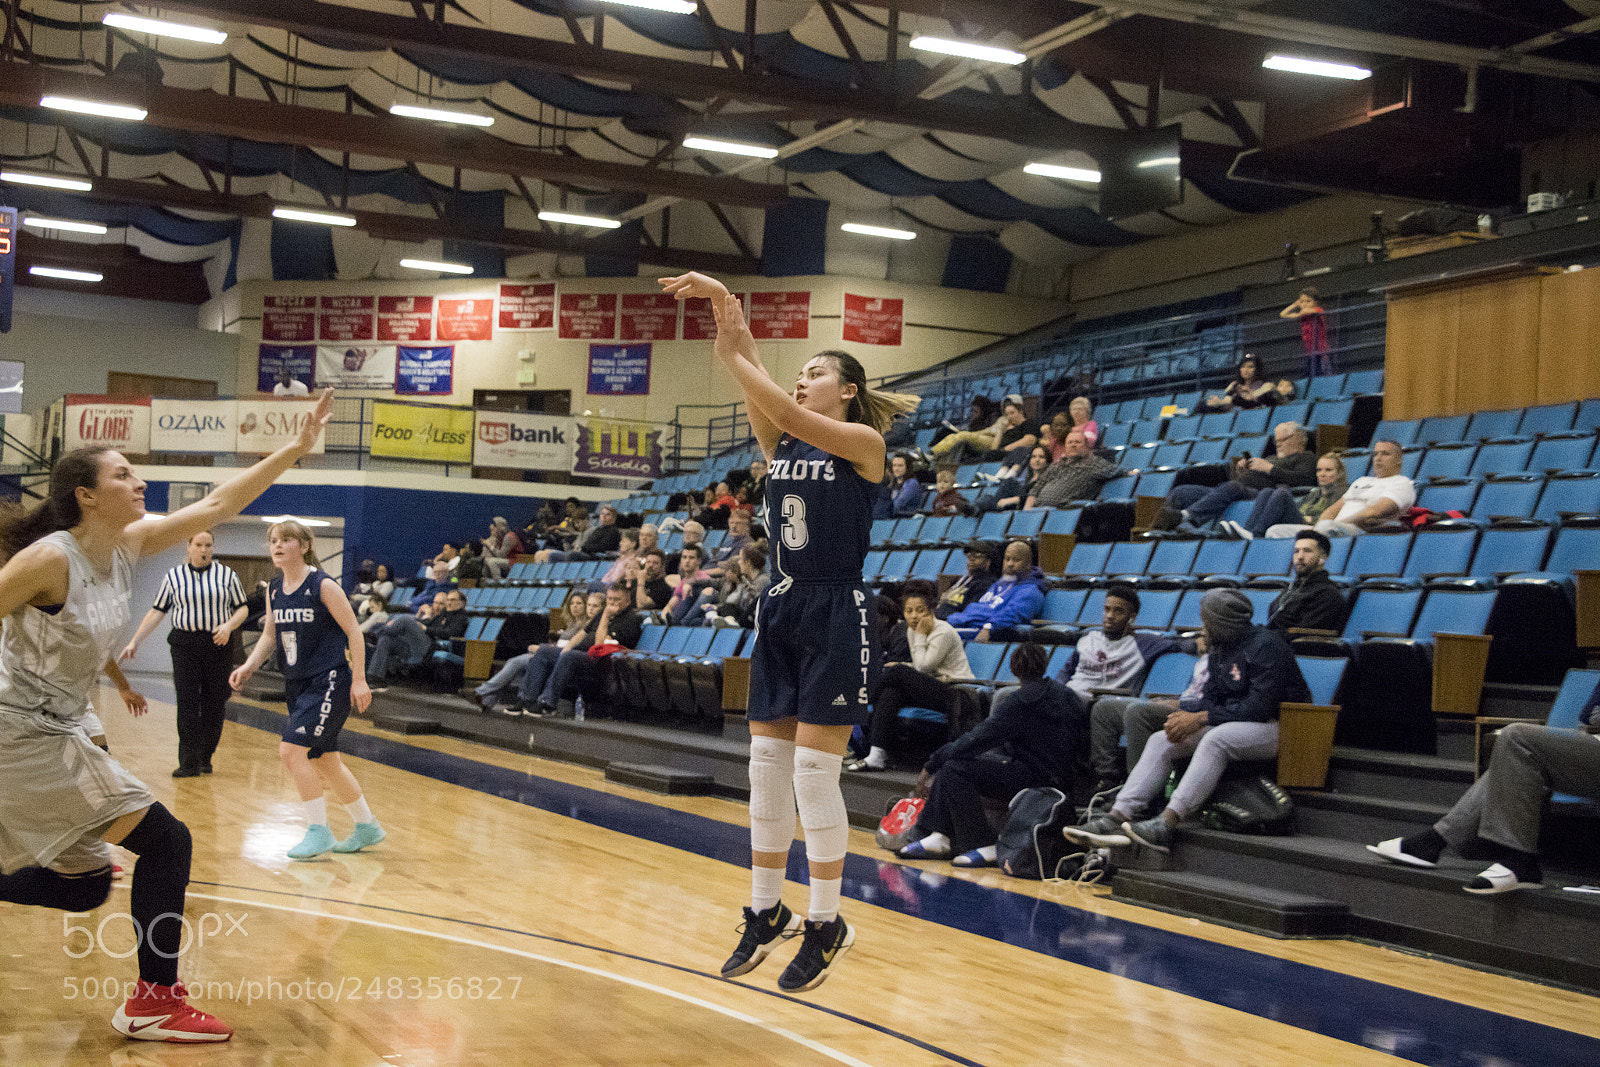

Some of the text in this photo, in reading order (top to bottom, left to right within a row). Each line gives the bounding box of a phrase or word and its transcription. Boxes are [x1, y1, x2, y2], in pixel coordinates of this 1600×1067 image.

[79, 408, 133, 441] GLOBE
[158, 413, 227, 434] OZARK
[588, 420, 653, 457] TILT
[588, 456, 651, 474] Studio
[781, 494, 809, 551] 3
[281, 630, 298, 667] 5
[853, 589, 870, 704] PILOTS
